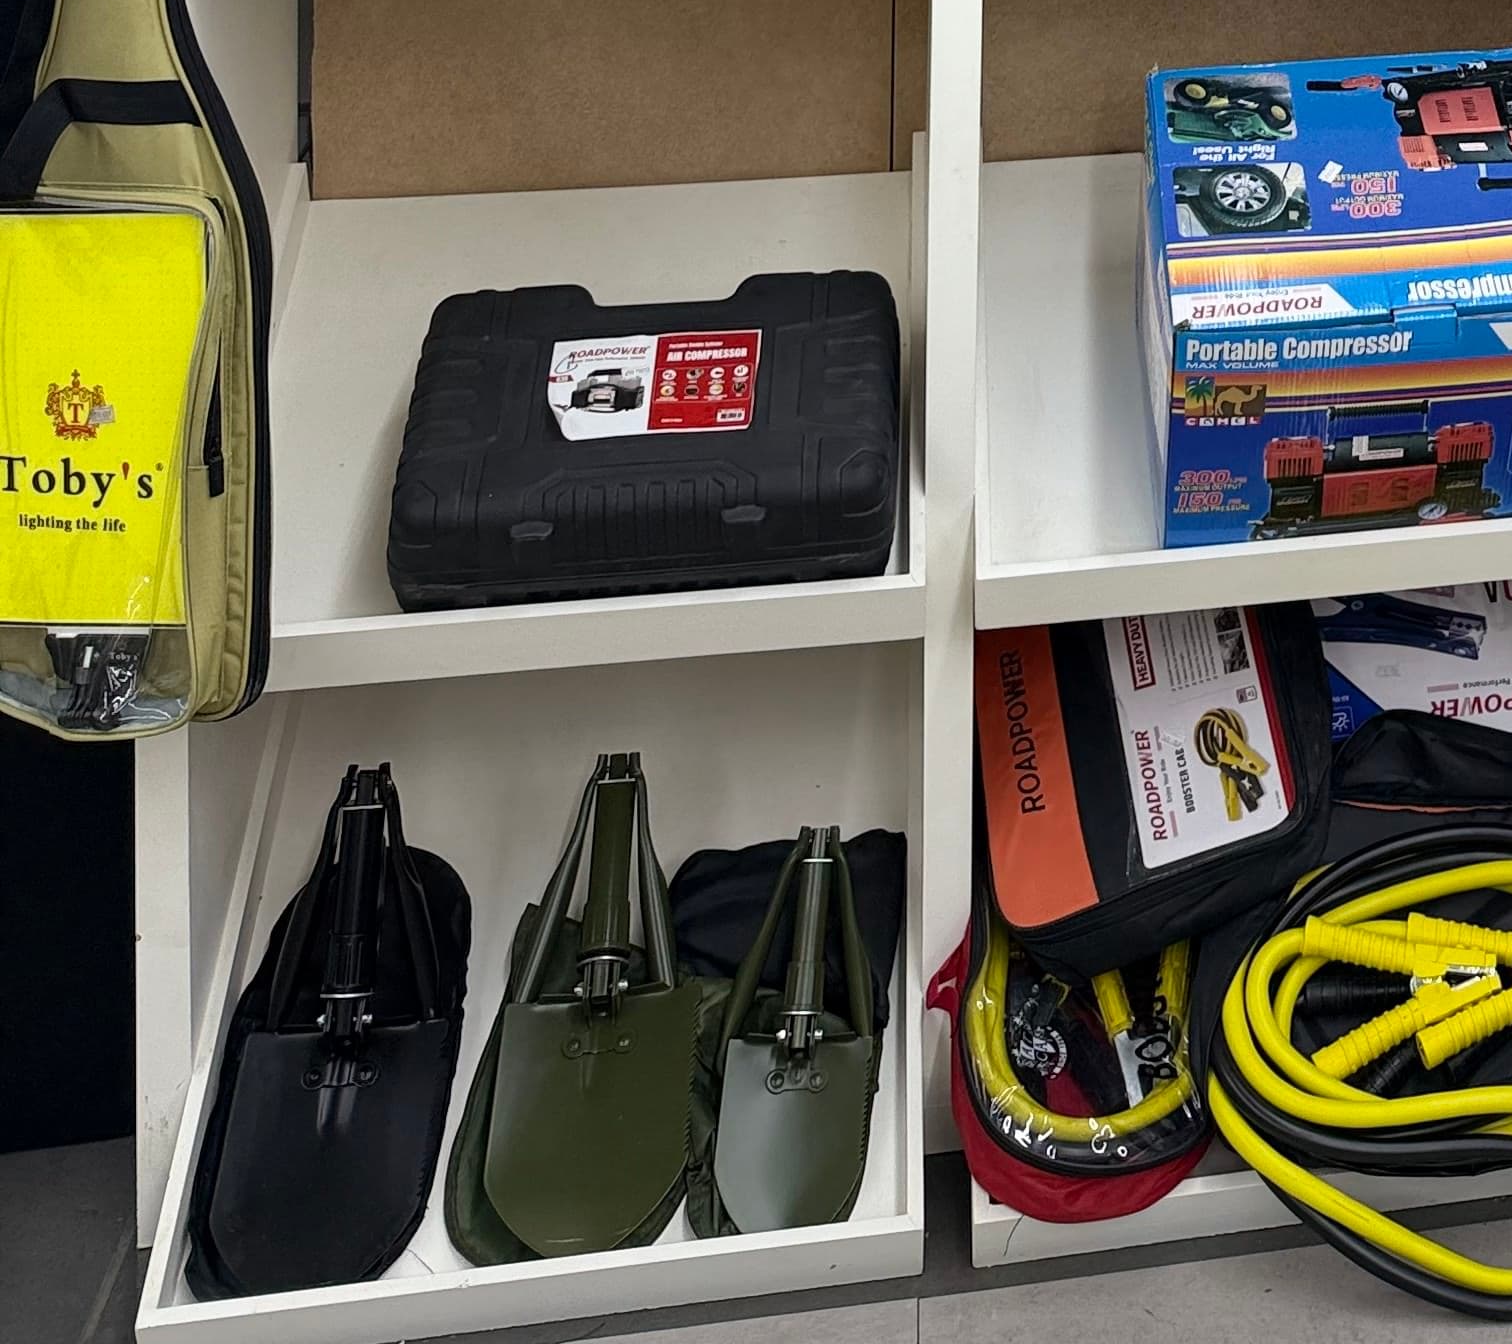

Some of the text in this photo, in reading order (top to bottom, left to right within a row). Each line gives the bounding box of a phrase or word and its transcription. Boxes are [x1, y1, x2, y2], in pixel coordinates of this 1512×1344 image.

[1351, 177, 1399, 195] 150
[1191, 295, 1323, 321] ROADPOWER
[569, 346, 649, 360] ROADPOWER
[667, 347, 748, 363] AIR COMPRESSOR
[1186, 330, 1413, 362] Portable Compressor
[1185, 361, 1280, 369] MAX VOLUME
[0, 456, 154, 509] Toby's
[1178, 469, 1230, 485] 300
[19, 513, 127, 533] lighting the life
[1132, 642, 1150, 683] HEAVY
[1001, 646, 1047, 815] ROADPOWER
[1135, 729, 1169, 842] ROADPOWER
